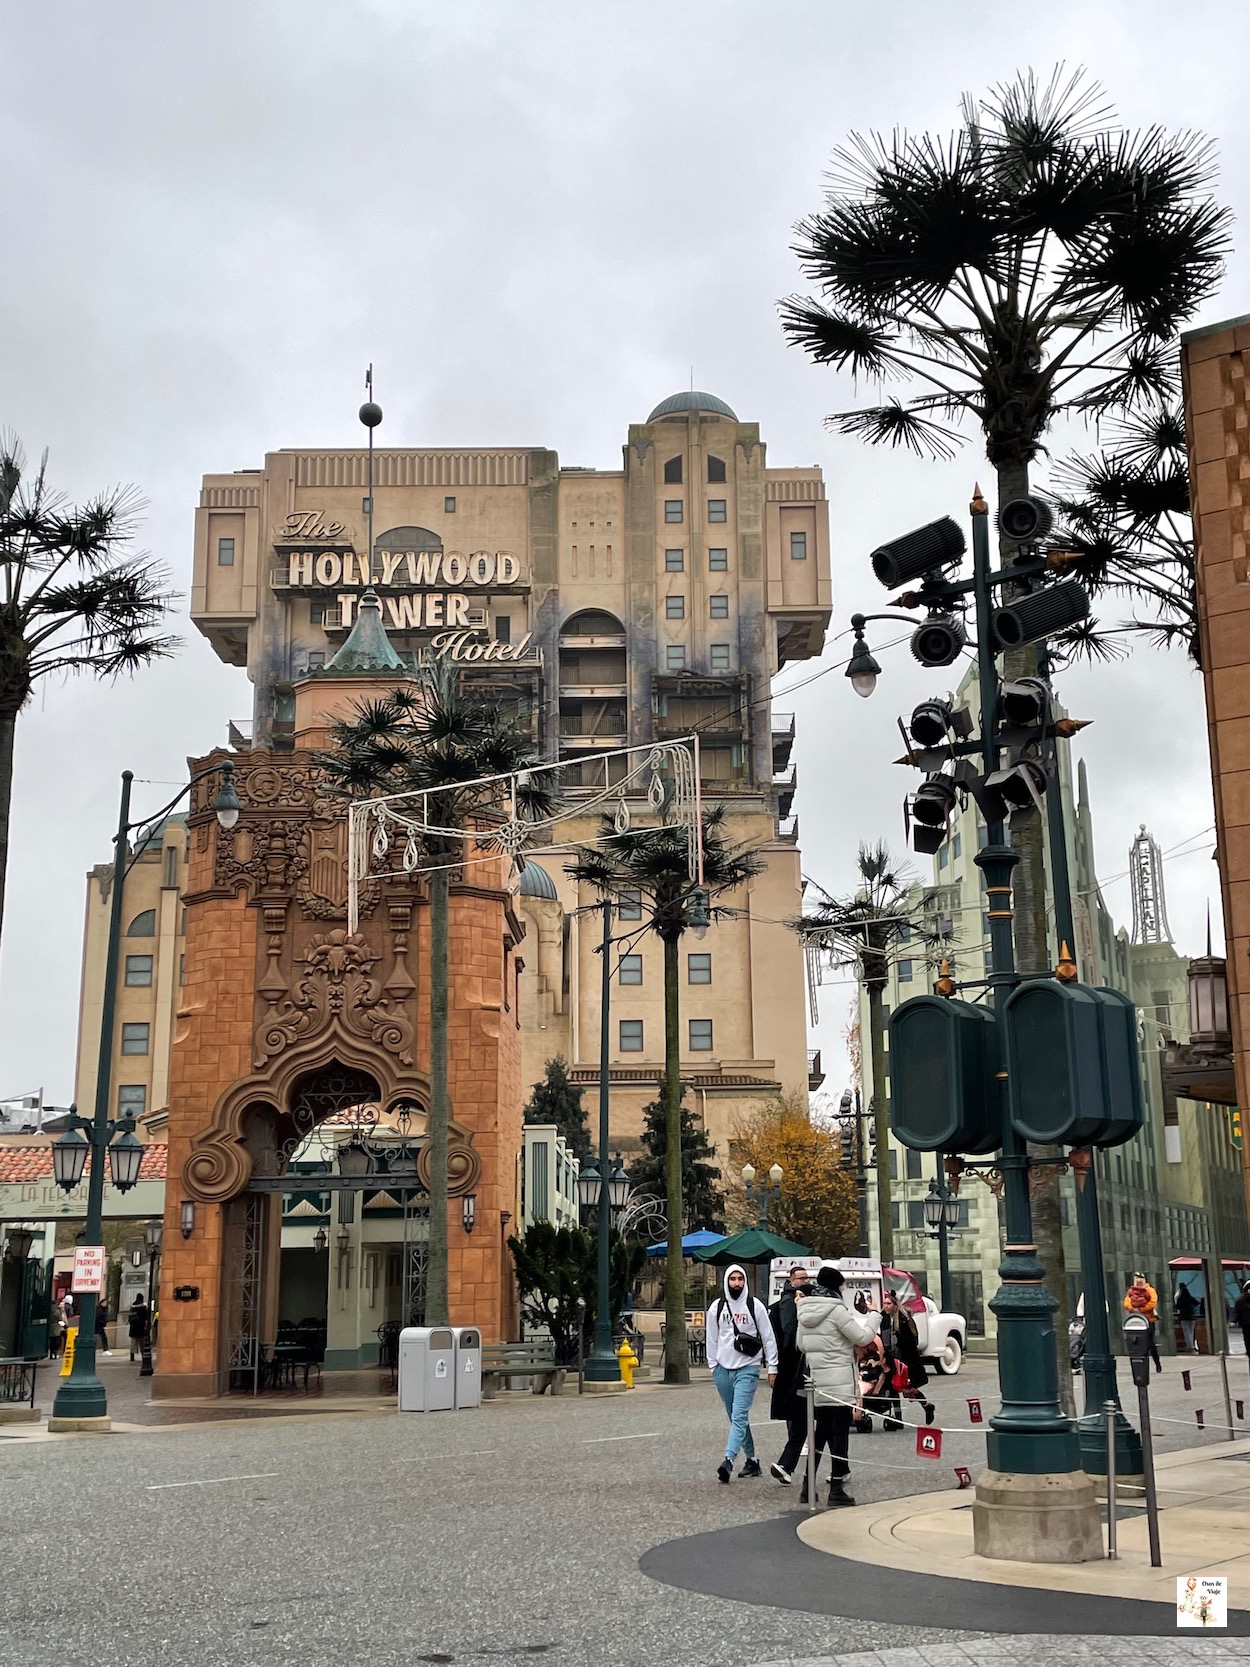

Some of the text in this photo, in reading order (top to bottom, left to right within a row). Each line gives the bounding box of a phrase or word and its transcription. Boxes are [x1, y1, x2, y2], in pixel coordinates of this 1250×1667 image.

[280, 510, 346, 538] The
[289, 550, 520, 586] HOLLYWOOD
[431, 630, 533, 661] Hotel
[21, 1185, 110, 1204] LA TERRAE
